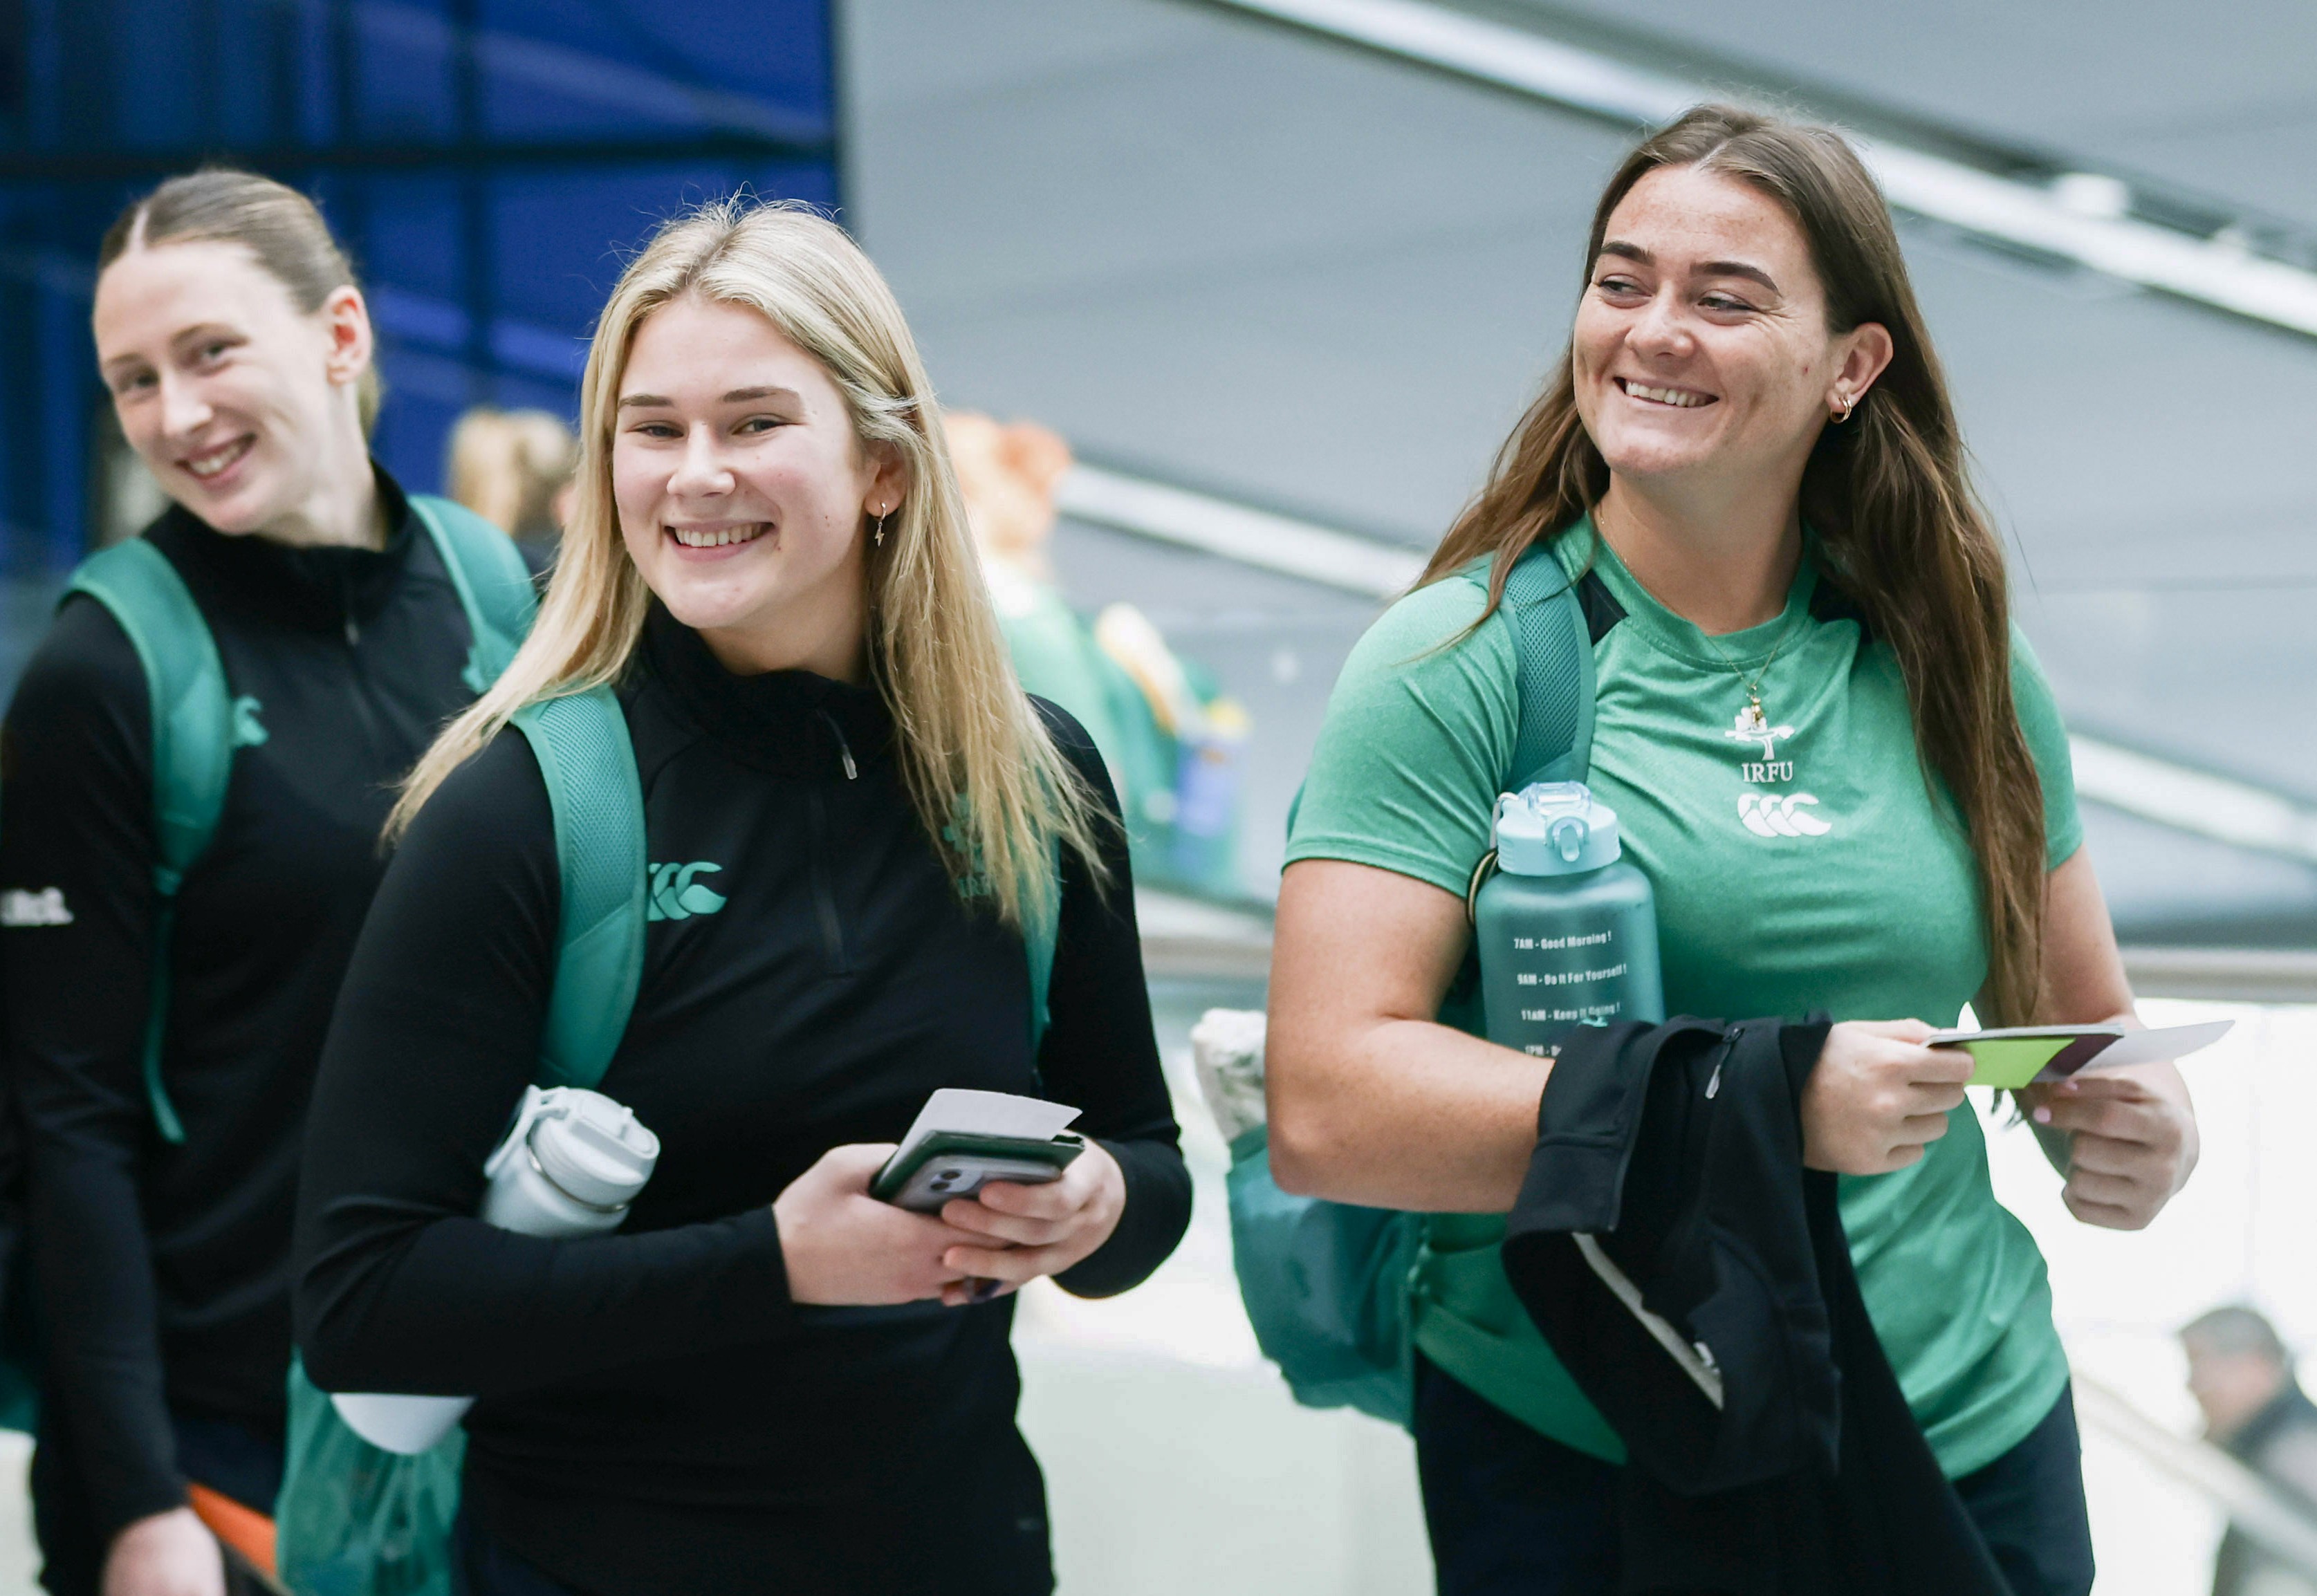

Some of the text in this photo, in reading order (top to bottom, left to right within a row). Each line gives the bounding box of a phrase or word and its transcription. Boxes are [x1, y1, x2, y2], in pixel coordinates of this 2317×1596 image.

[1742, 761, 1793, 783] IRFU
[1514, 938, 1533, 949] 7AM
[1541, 936, 1565, 949] Good
[1517, 974, 1537, 985] 9AM
[1544, 974, 1557, 985] Do
[1567, 972, 1584, 983] For
[1522, 1010, 1547, 1021] 11AM
[1553, 1010, 1578, 1021] Keep
